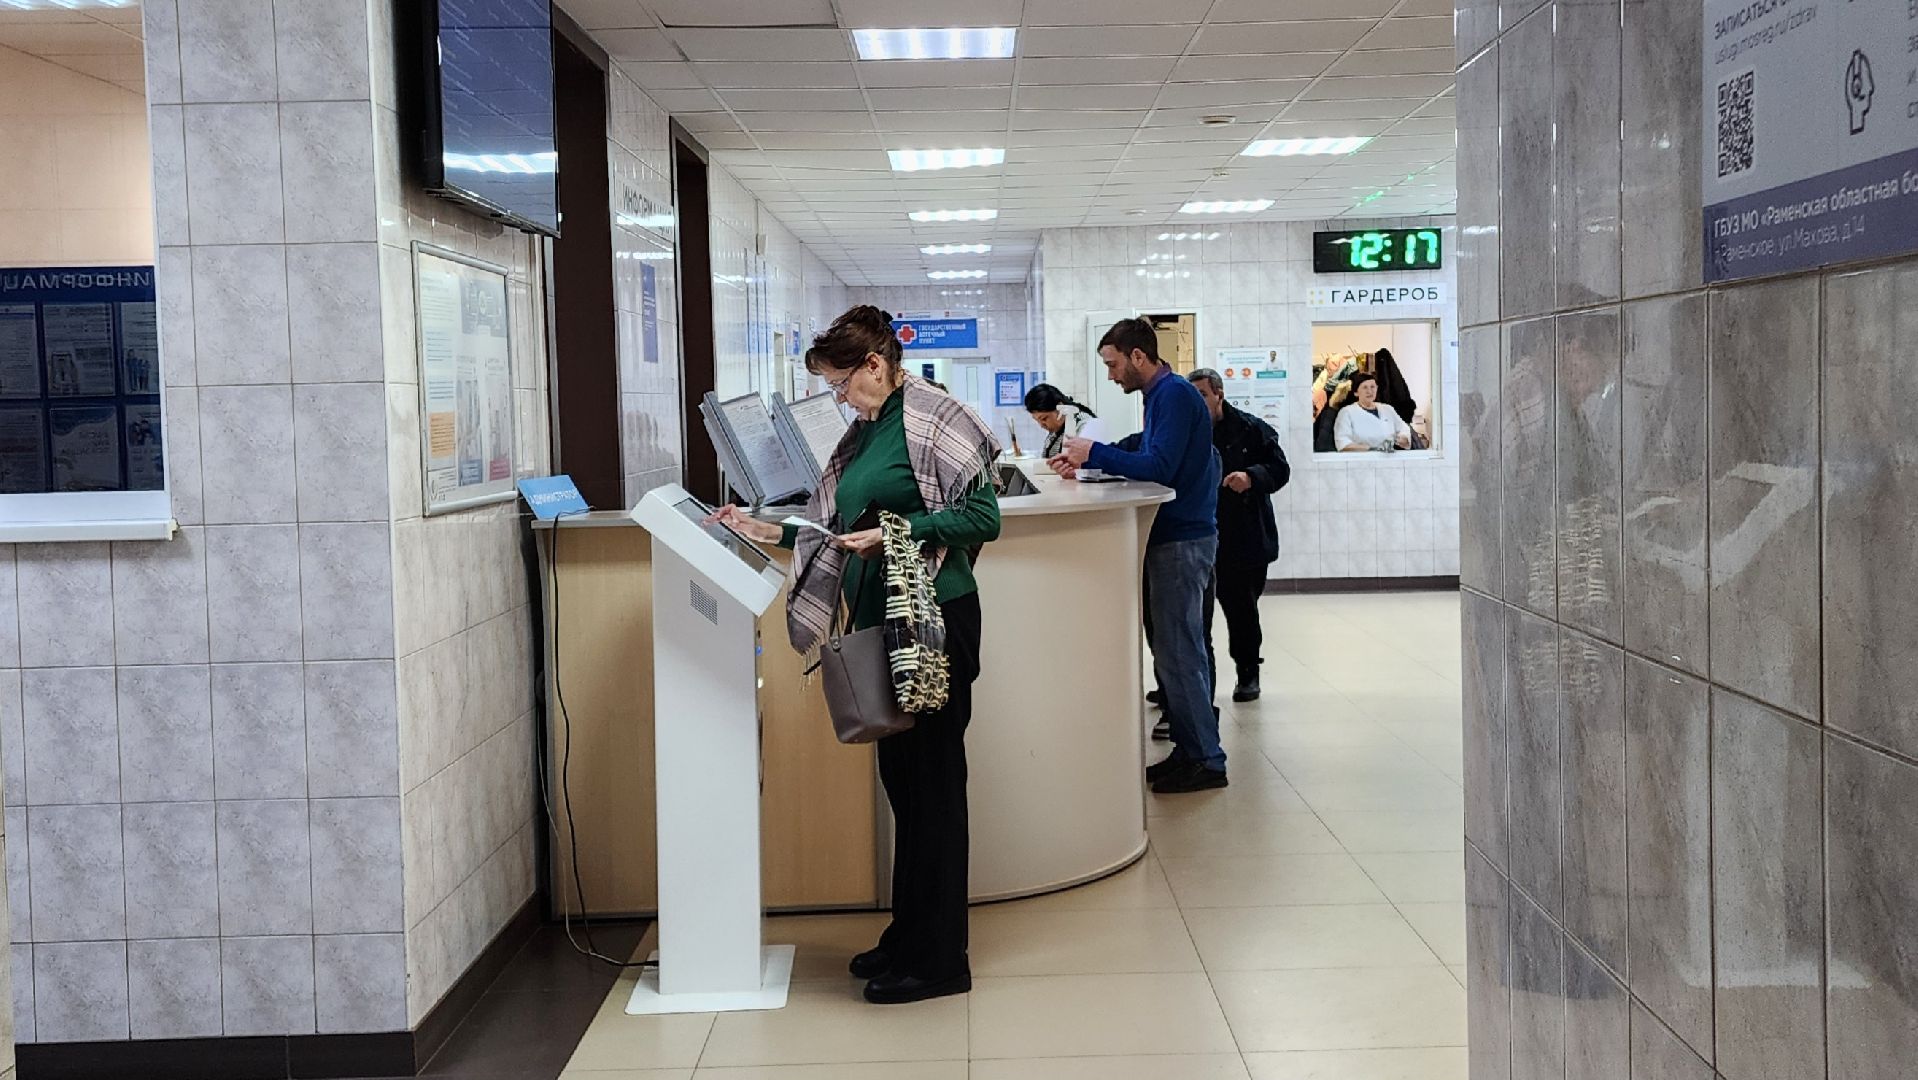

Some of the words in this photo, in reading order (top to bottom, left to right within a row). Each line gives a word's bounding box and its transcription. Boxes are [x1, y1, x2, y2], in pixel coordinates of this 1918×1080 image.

[1714, 213, 1740, 238] ГБУЗ
[1741, 209, 1759, 232] МО
[1830, 179, 1899, 211] областная
[1350, 231, 1438, 269] 12:17
[1331, 287, 1438, 305] ГАРДЕРОБ
